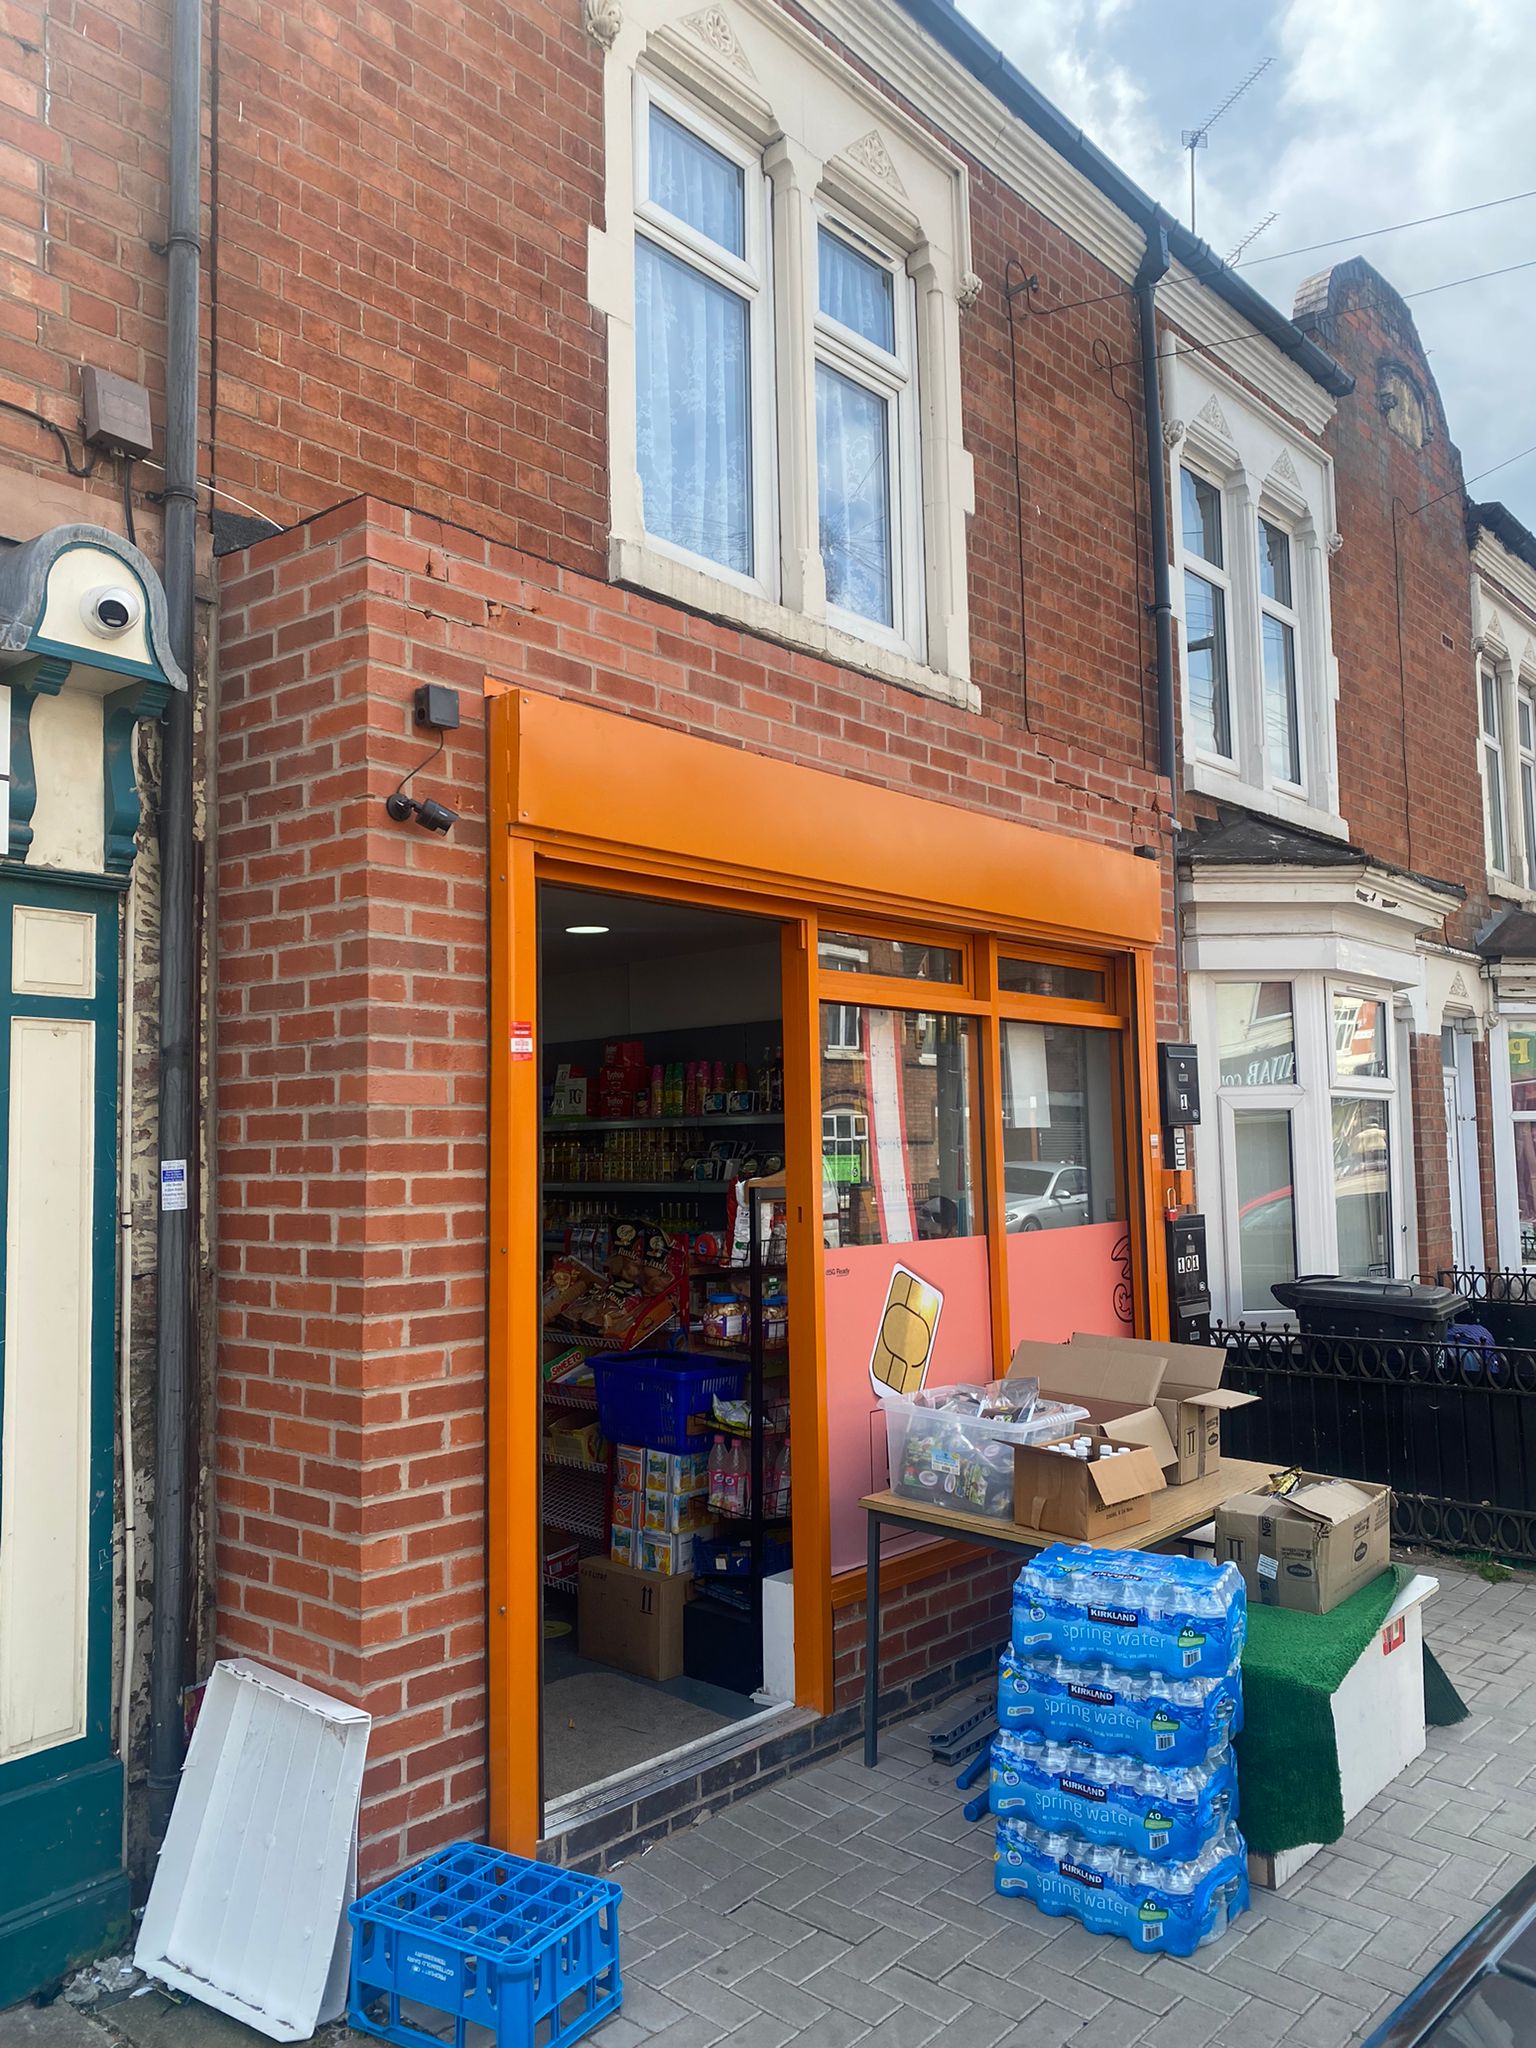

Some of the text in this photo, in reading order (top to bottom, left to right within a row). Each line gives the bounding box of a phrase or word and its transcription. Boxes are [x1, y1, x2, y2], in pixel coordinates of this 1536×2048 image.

[569, 1089, 584, 1104] PG
[1179, 1256, 1199, 1272] 101
[551, 1351, 582, 1377] SWEETO
[1090, 1608, 1137, 1623] KIRKLAND
[1063, 1625, 1112, 1646] spring
[1117, 1634, 1167, 1649] water
[1071, 1685, 1113, 1701] KIRKLAND
[1044, 1698, 1091, 1722] spring
[1094, 1711, 1141, 1730] water
[1155, 1714, 1168, 1722] 40
[1062, 1779, 1105, 1797] KIRKLAND
[1035, 1792, 1083, 1819] spring
[1086, 1806, 1135, 1827] water
[1062, 1862, 1103, 1884] KIRKLAND
[1036, 1875, 1081, 1904] spring
[1084, 1891, 1130, 1917] water
[1143, 1902, 1157, 1911] 40
